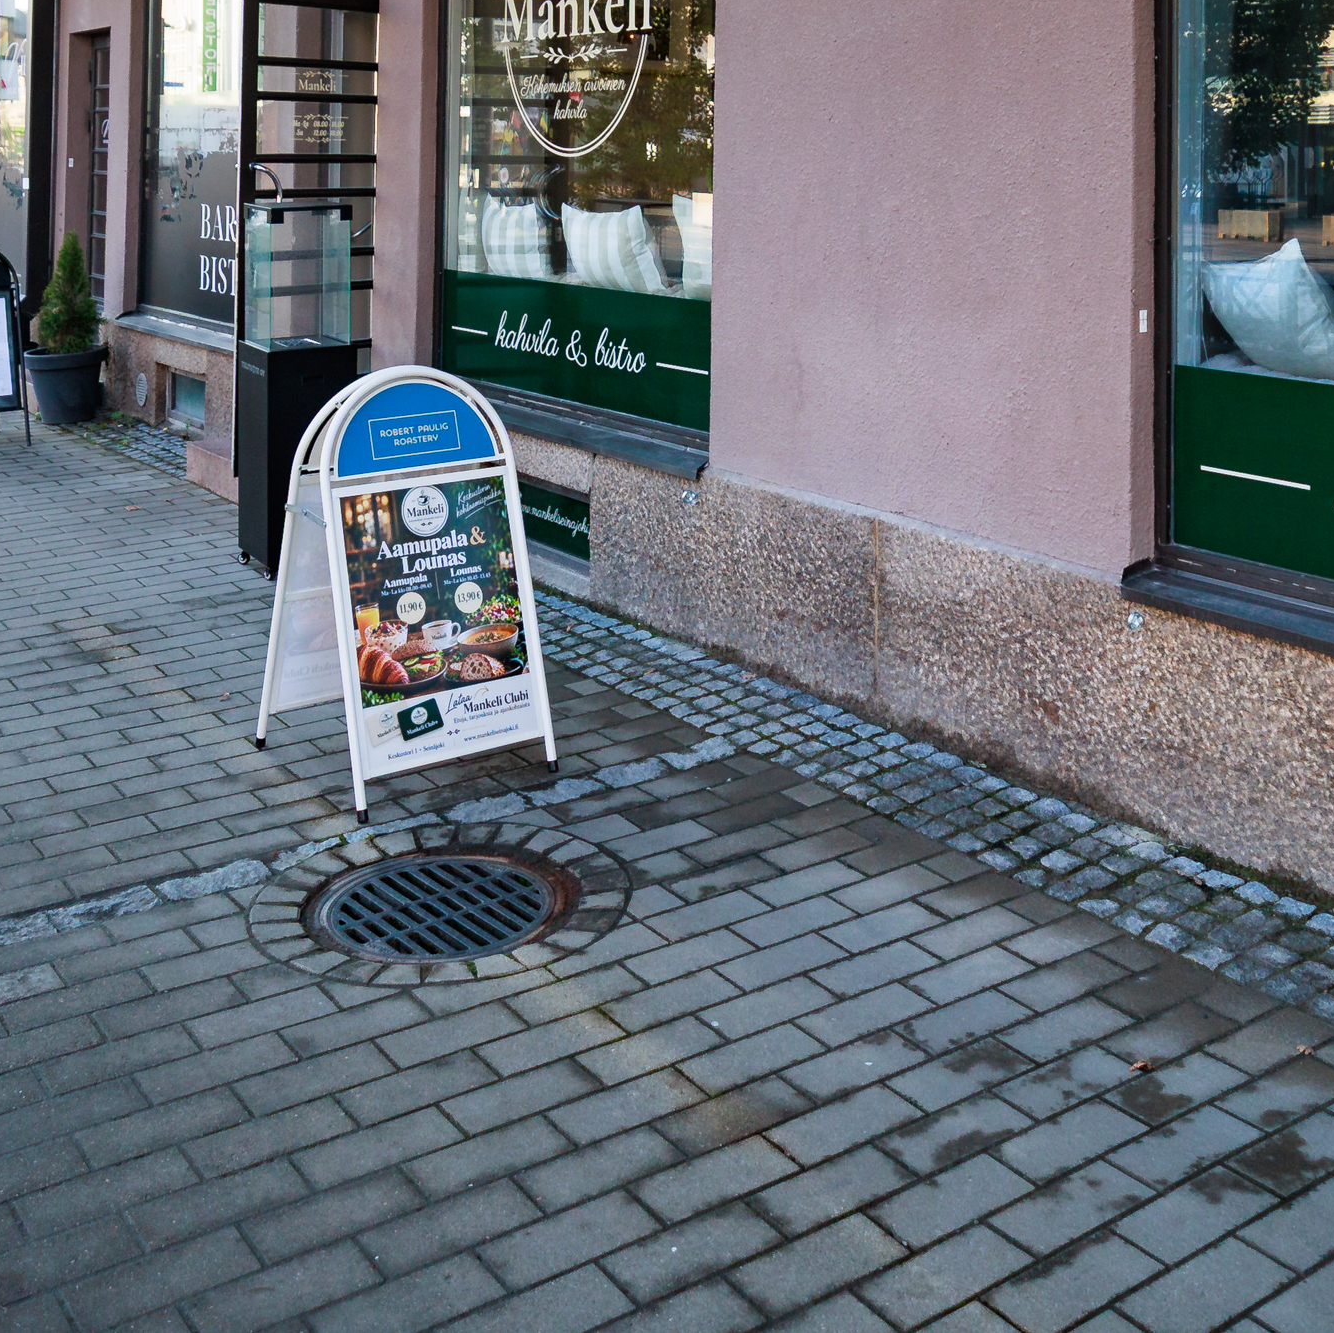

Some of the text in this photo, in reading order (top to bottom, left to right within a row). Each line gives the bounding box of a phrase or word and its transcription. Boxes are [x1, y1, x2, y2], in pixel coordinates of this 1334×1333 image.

[298, 78, 337, 92] Mankeli
[520, 73, 582, 97] Kokemuksen
[553, 99, 588, 120] kahvila
[200, 203, 237, 242] BAR
[199, 254, 236, 296] BIST
[494, 310, 647, 374] kahvila & bistro
[379, 422, 449, 438] ROBERT PAULIG
[393, 434, 439, 447] ROASTERY
[406, 503, 445, 518] Mankeli
[376, 525, 487, 561] Aamupala &
[401, 551, 467, 575] Lounas
[450, 564, 483, 578] Lounas
[383, 573, 428, 589] Aamupala
[457, 591, 476, 604] 13,90
[399, 602, 418, 614] 11,90
[445, 692, 473, 715] Lataa
[463, 689, 529, 715] Mankeli Clubi
[387, 748, 415, 761] Keskustori
[422, 742, 446, 752] Seinäjoki
